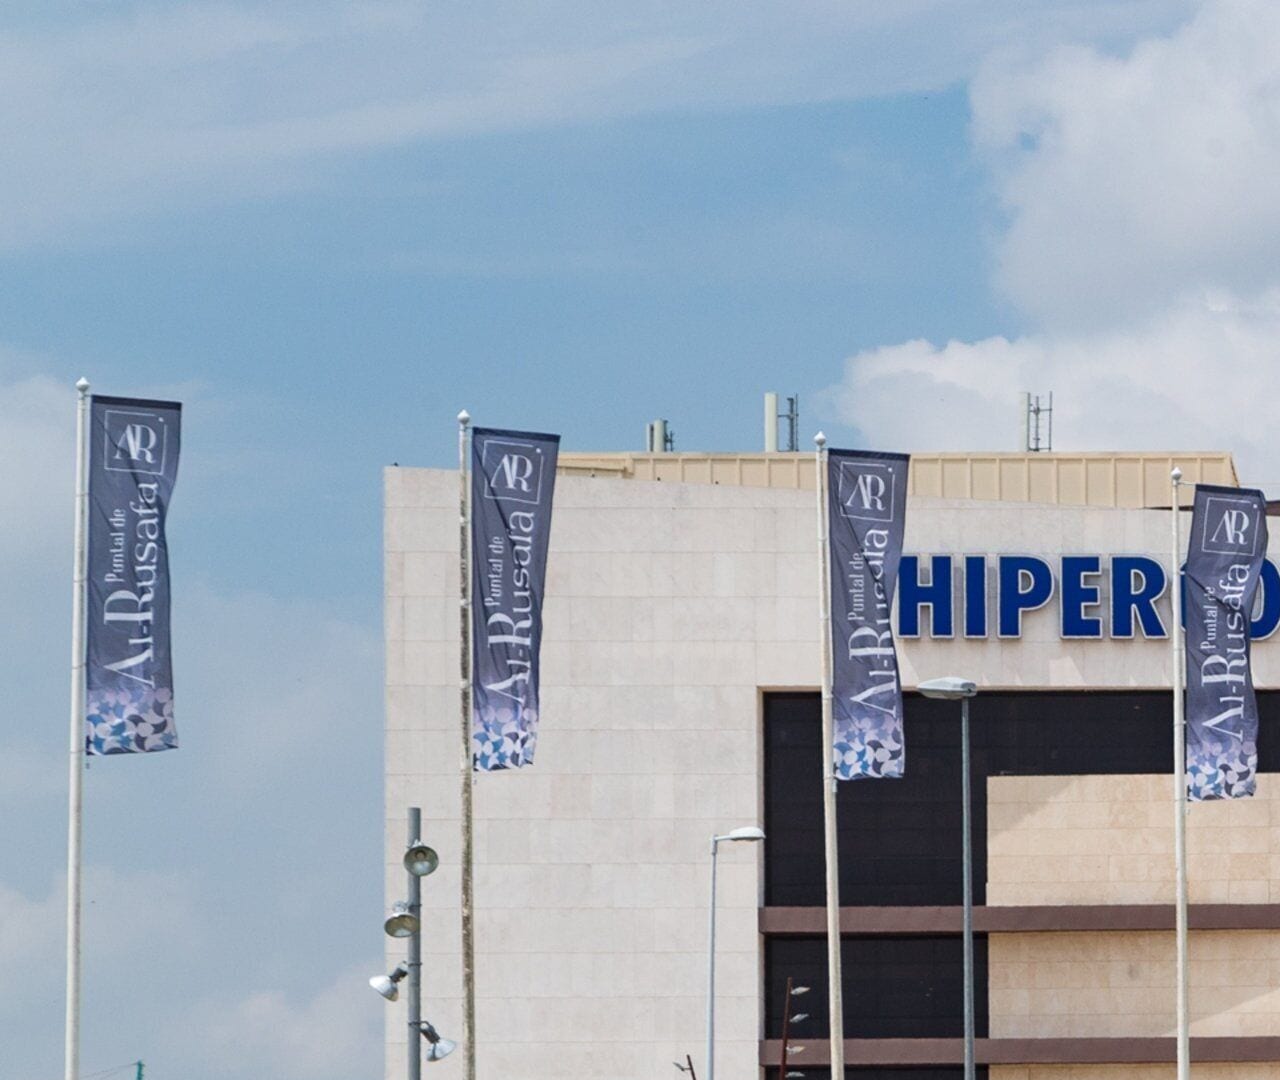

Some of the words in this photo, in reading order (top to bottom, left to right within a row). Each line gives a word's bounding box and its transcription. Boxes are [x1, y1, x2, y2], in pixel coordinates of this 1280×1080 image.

[109, 508, 126, 528] de
[105, 531, 125, 583] Puntal
[489, 536, 505, 556] de
[850, 552, 863, 570] de
[484, 559, 504, 608] Puntal
[848, 573, 865, 622] Puntal
[1200, 604, 1218, 651] Puntal
